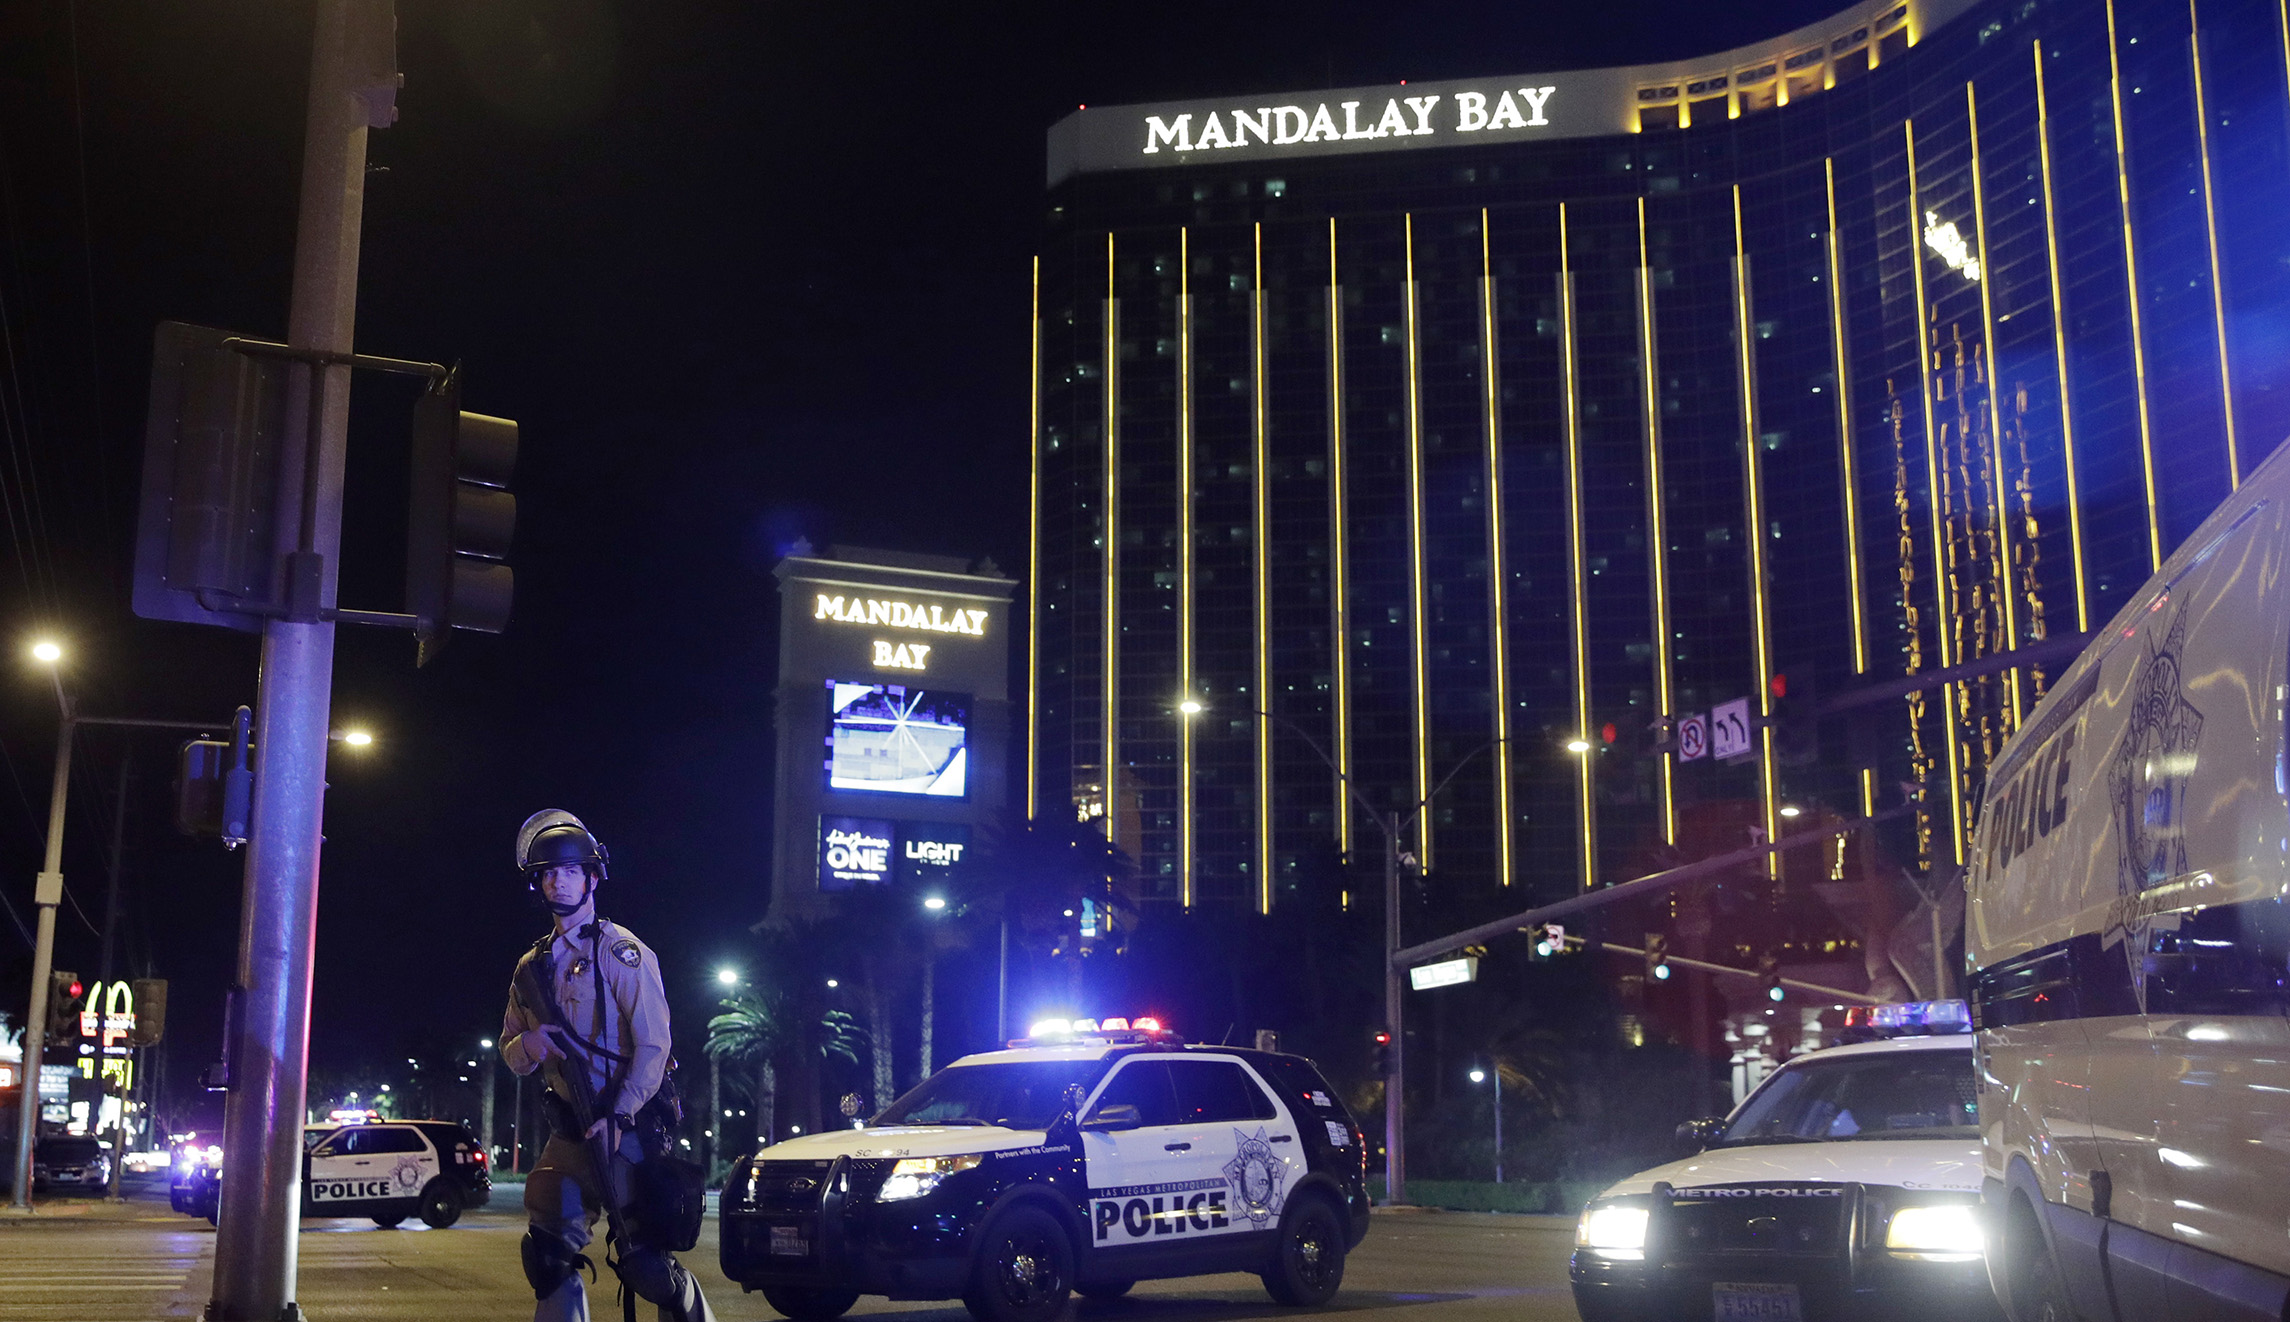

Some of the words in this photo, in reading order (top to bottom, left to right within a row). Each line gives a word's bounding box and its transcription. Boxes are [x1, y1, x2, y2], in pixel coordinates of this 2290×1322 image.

[1142, 95, 1440, 154] MANDALAY
[1455, 86, 1556, 132] BAY
[815, 594, 989, 636] MANDALAY
[873, 640, 931, 671] BAY
[1985, 722, 2077, 883] POLICE
[826, 846, 888, 871] ONE
[906, 840, 964, 862] LIGHT
[855, 1148, 872, 1157] SC
[994, 1151, 1019, 1160] Partners
[1019, 1148, 1031, 1156] with
[1040, 1144, 1071, 1154] Community
[313, 1181, 390, 1199] POLICE
[1100, 1189, 1117, 1197] LAS
[1121, 1185, 1151, 1195] VEGAS
[1154, 1179, 1220, 1192] METROPOLITAN
[1665, 1188, 1751, 1198] METRO
[1096, 1191, 1229, 1240] POLICE
